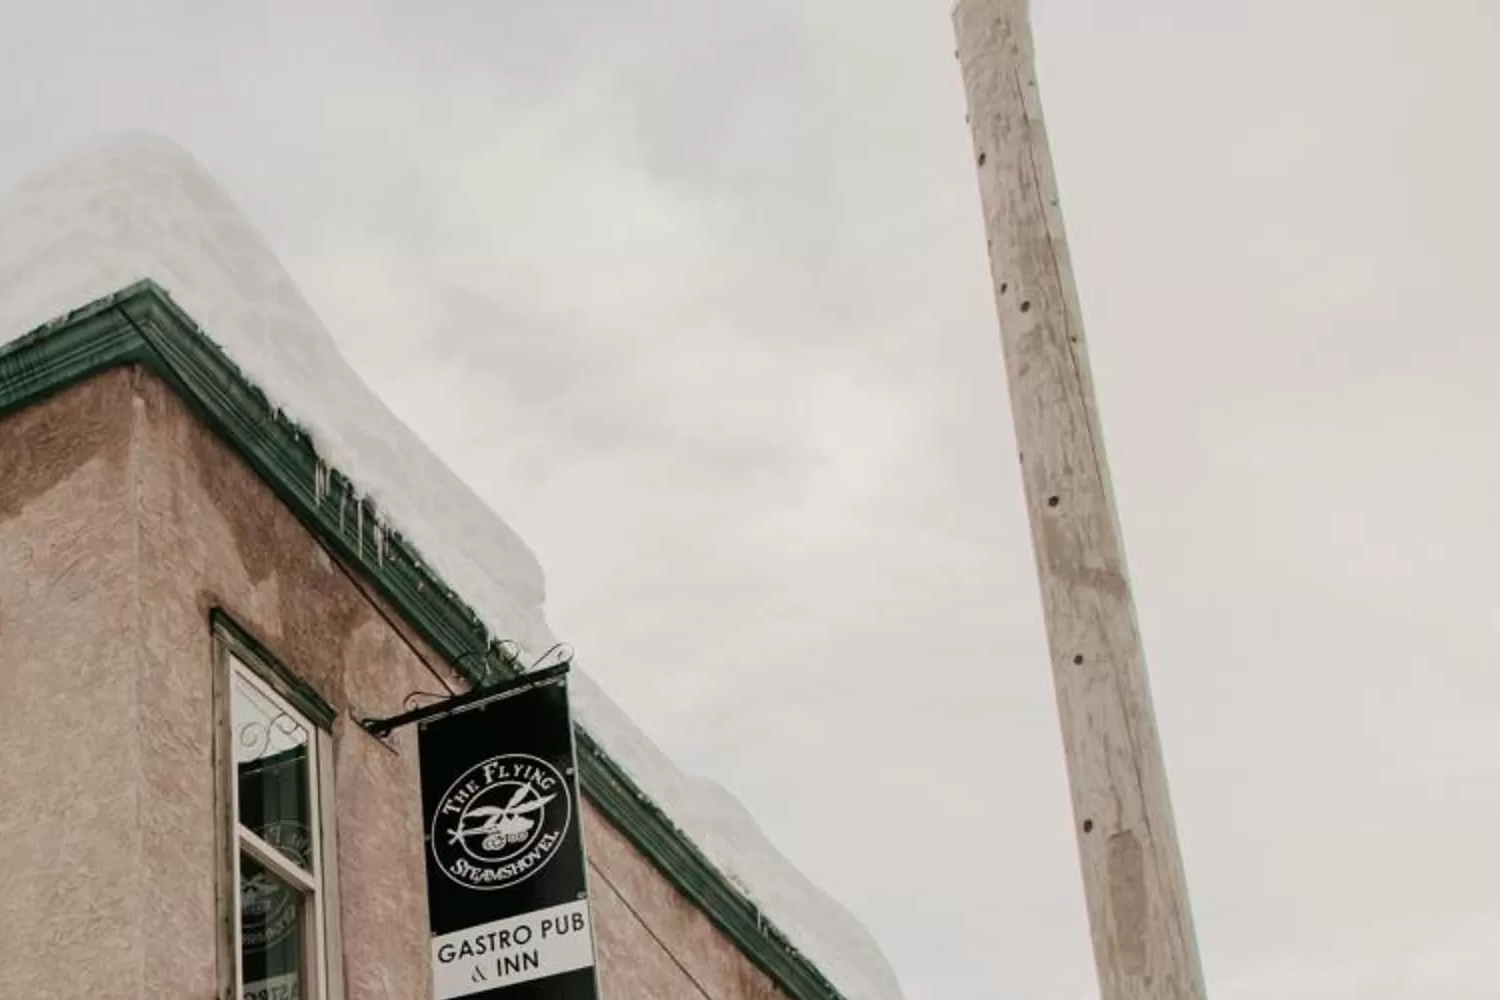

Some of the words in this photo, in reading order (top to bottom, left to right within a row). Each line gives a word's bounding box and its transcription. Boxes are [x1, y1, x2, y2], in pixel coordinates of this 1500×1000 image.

[450, 831, 560, 883] STEAMSHOVEL
[437, 925, 532, 963] GASTRO
[541, 912, 585, 939] PUB
[496, 949, 539, 977] INN
